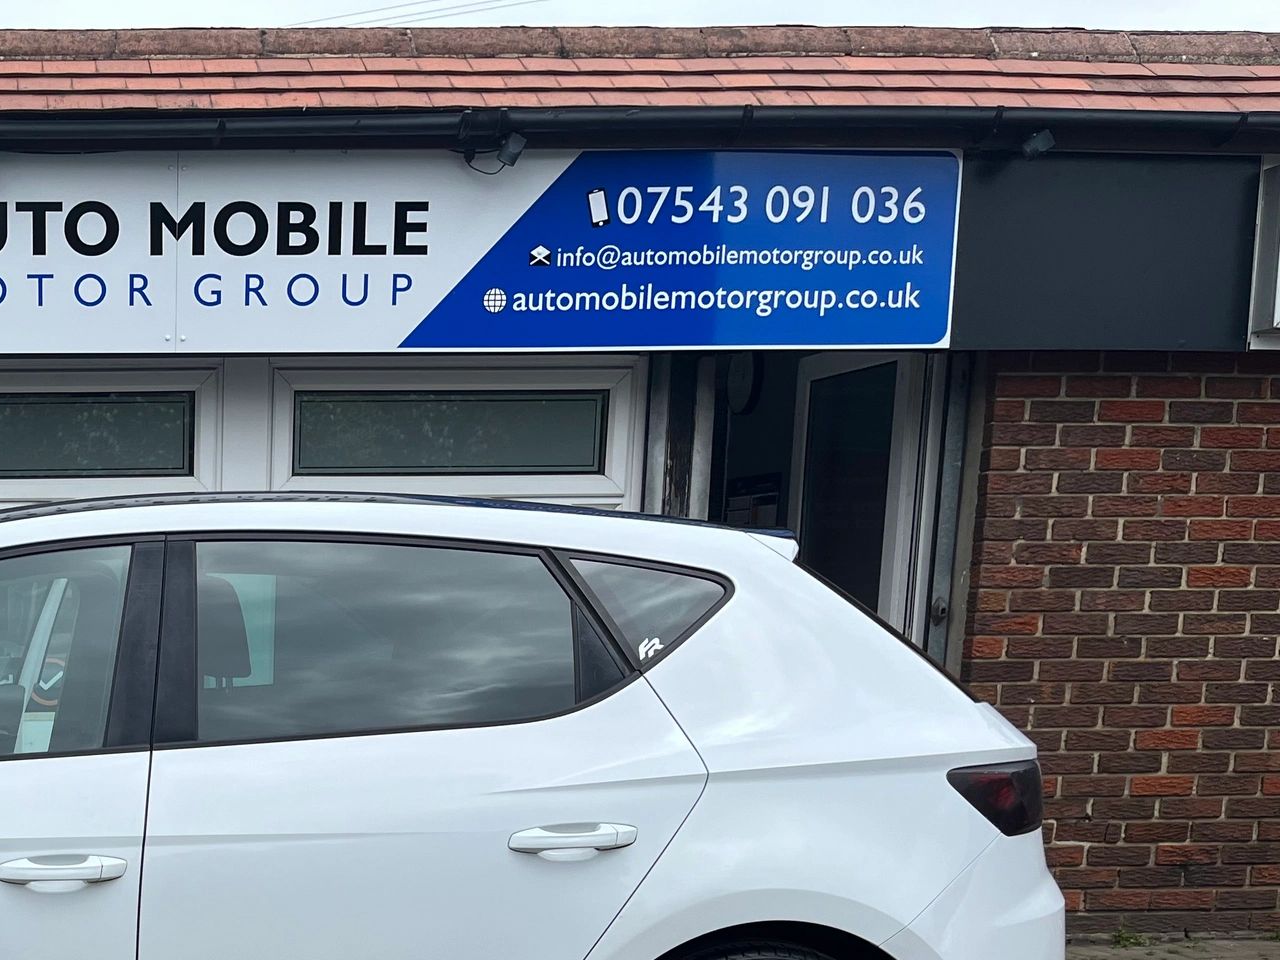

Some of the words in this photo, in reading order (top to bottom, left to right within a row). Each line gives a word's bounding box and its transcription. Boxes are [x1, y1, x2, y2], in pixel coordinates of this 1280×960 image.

[618, 185, 748, 225] 07543
[765, 185, 829, 225] 091
[851, 186, 926, 225] 036
[149, 200, 430, 257] MOBILE
[556, 244, 924, 271] info@automobilemotorgroup.co.uk
[193, 273, 413, 307] GROUP
[512, 281, 920, 317] automobilemotorgroup.co.uk
